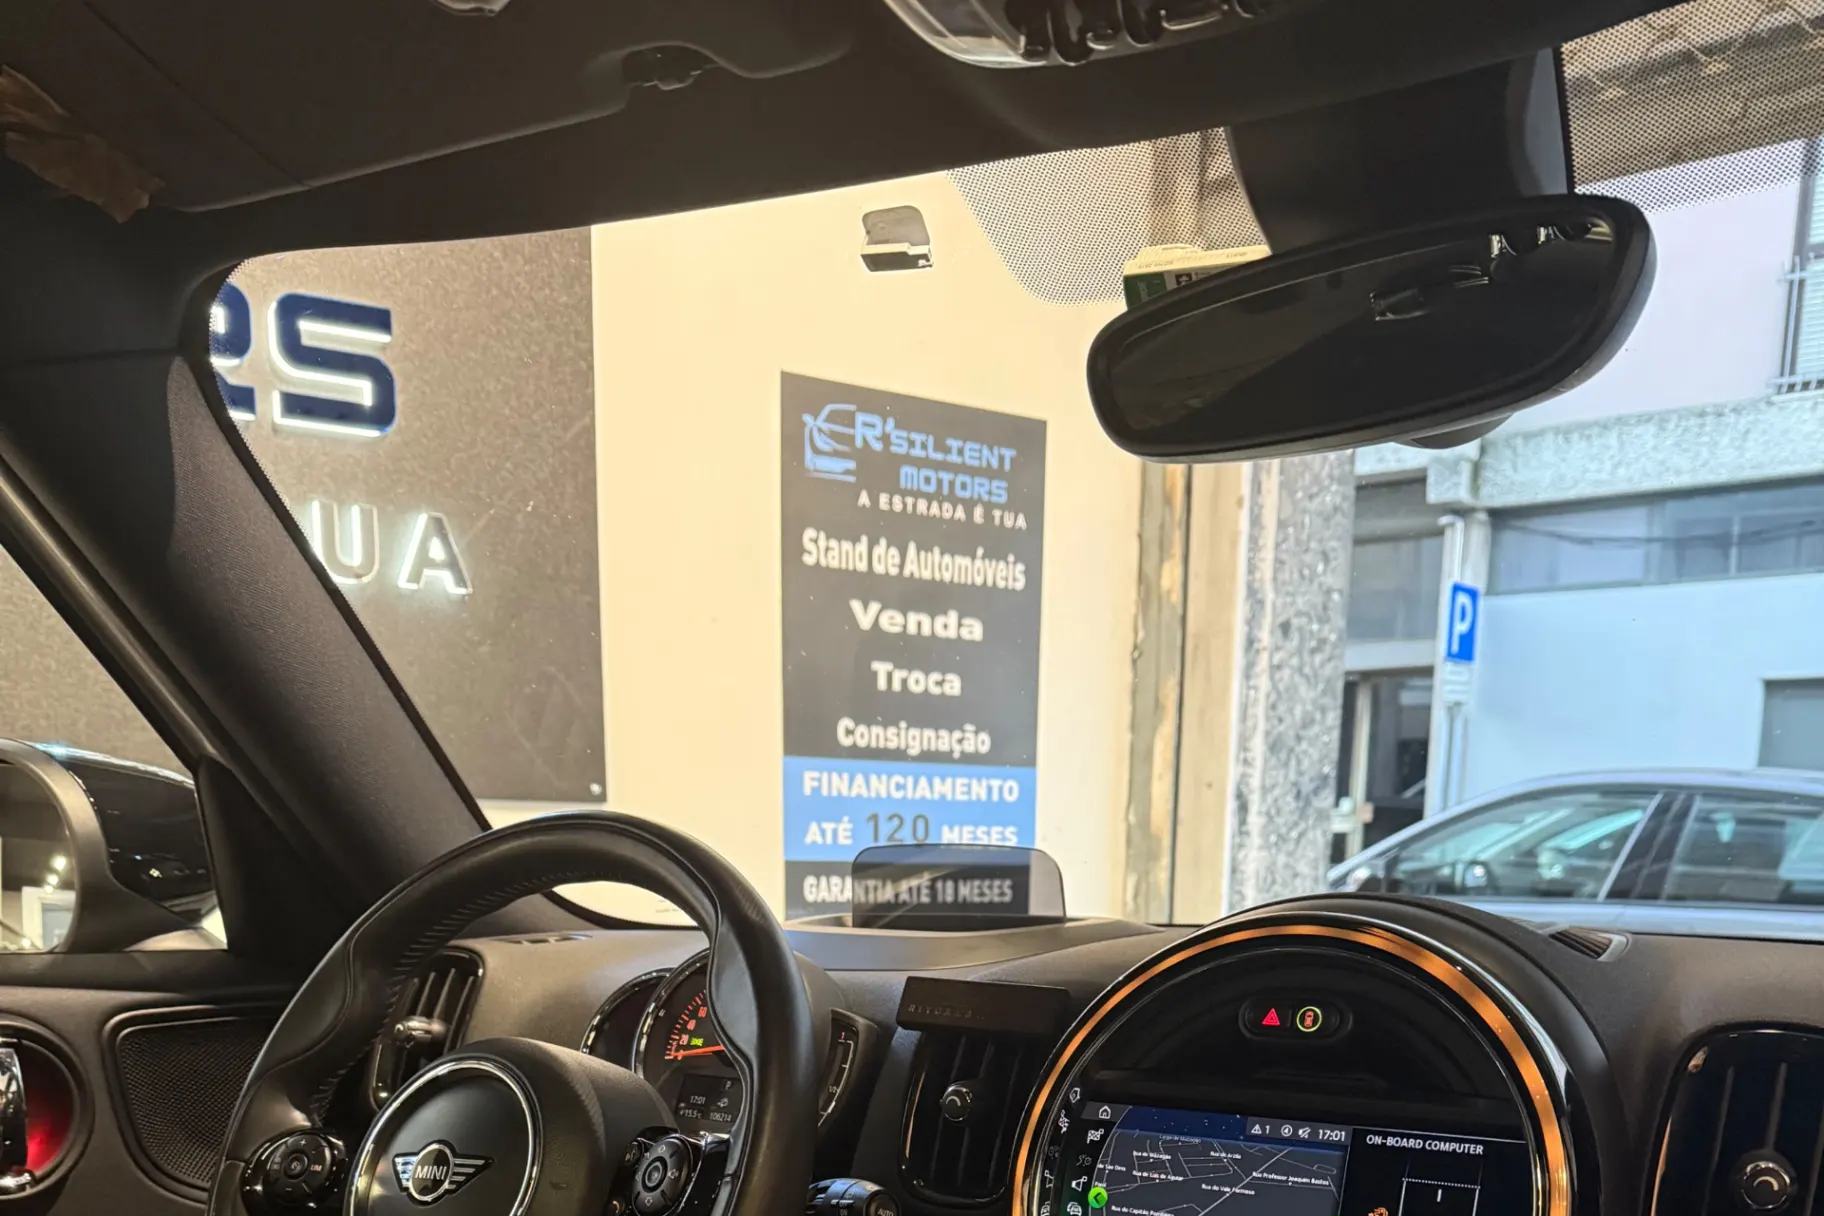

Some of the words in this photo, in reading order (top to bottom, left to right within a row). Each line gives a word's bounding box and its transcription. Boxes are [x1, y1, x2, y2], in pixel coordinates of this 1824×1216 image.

[900, 465, 1008, 504] MOTORS
[857, 489, 871, 507] A
[879, 493, 966, 523] ESTRADA
[973, 503, 985, 525] É
[992, 509, 1027, 530] TUA
[802, 527, 869, 572] Stand
[872, 537, 900, 577] de
[903, 541, 1025, 591] Automóveis
[850, 599, 983, 642] Venda
[1451, 591, 1473, 655] P
[871, 661, 962, 697] Troca
[836, 717, 991, 759] Consignação
[803, 771, 1019, 803] FINANCIAMENTO
[805, 817, 853, 845] ATÉ
[866, 812, 930, 844] 120
[941, 825, 1018, 847] MESES
[803, 875, 896, 904] GARANTIA
[957, 878, 1013, 905] MESES
[1318, 1129, 1346, 1142] 17:01
[1366, 1134, 1423, 1149] ON-BOARD
[1425, 1140, 1484, 1155] COMPUTER
[415, 1165, 447, 1180] MINI
